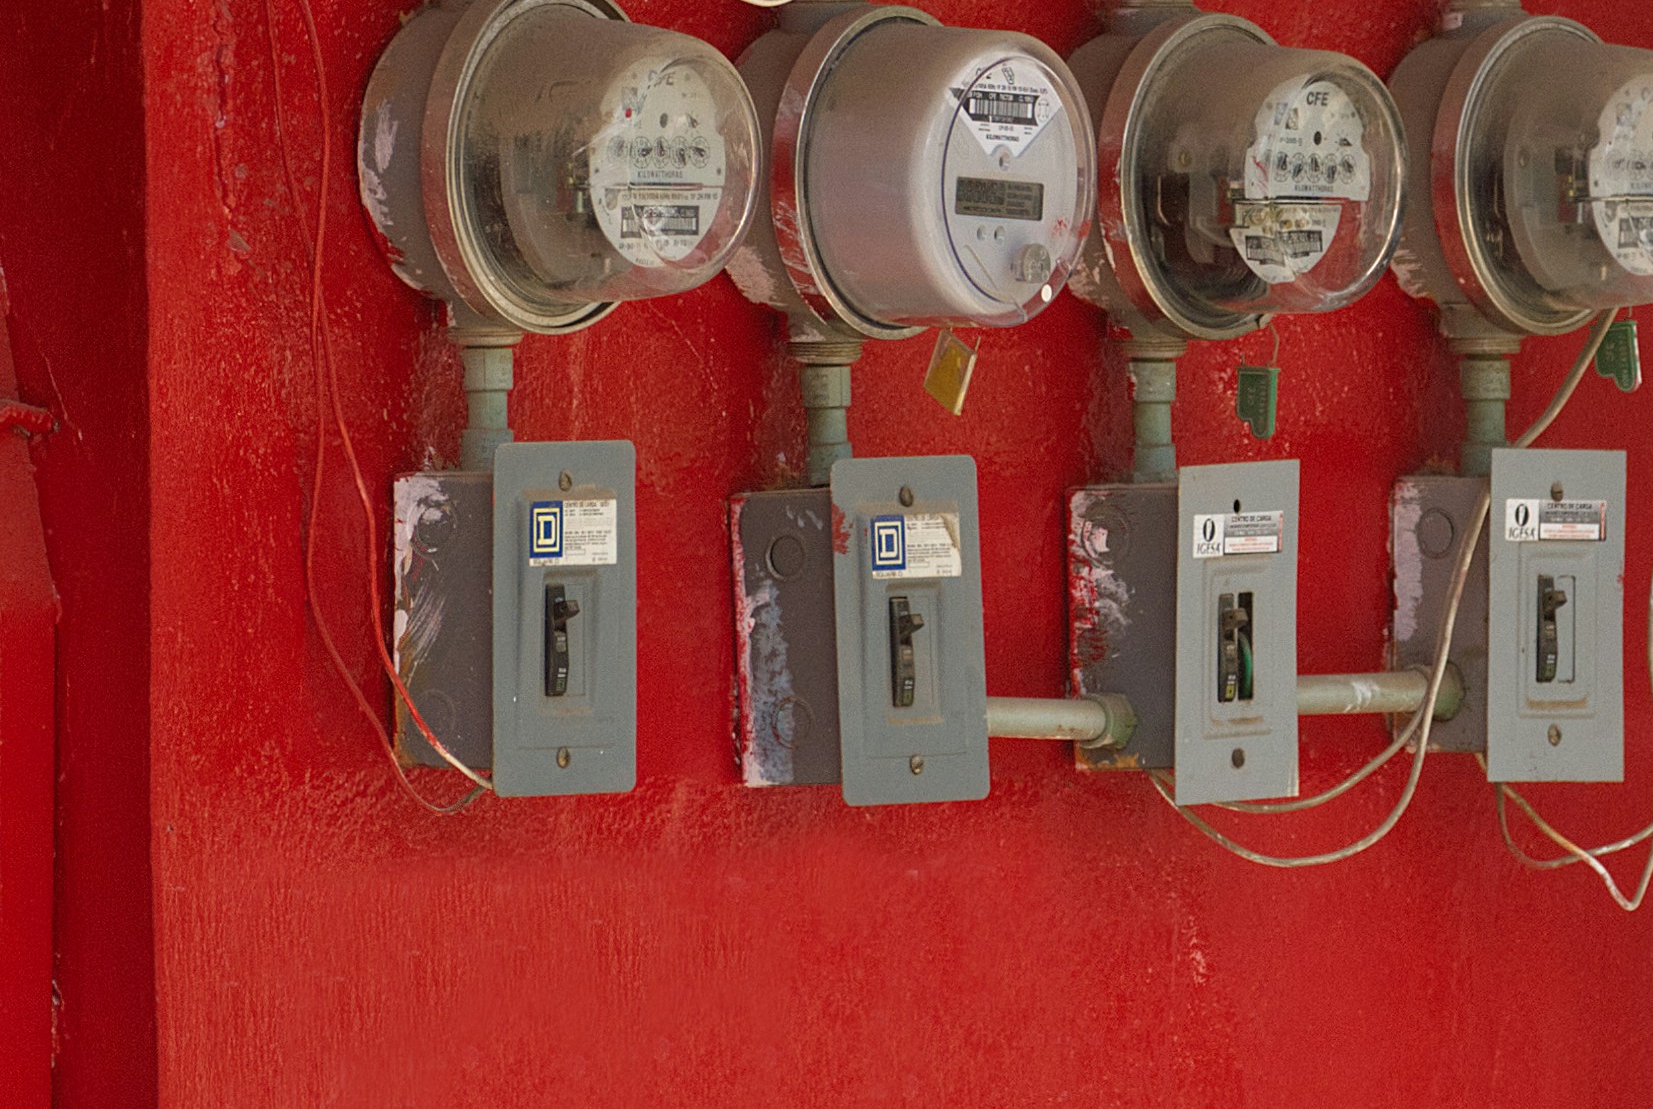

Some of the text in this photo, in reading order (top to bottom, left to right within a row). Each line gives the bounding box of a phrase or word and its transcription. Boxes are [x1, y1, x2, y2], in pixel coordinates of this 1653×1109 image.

[1306, 91, 1329, 105] CFE
[538, 515, 556, 546] D
[1508, 527, 1535, 539] IGESA
[879, 528, 898, 559] D
[1197, 542, 1221, 555] IGESA
